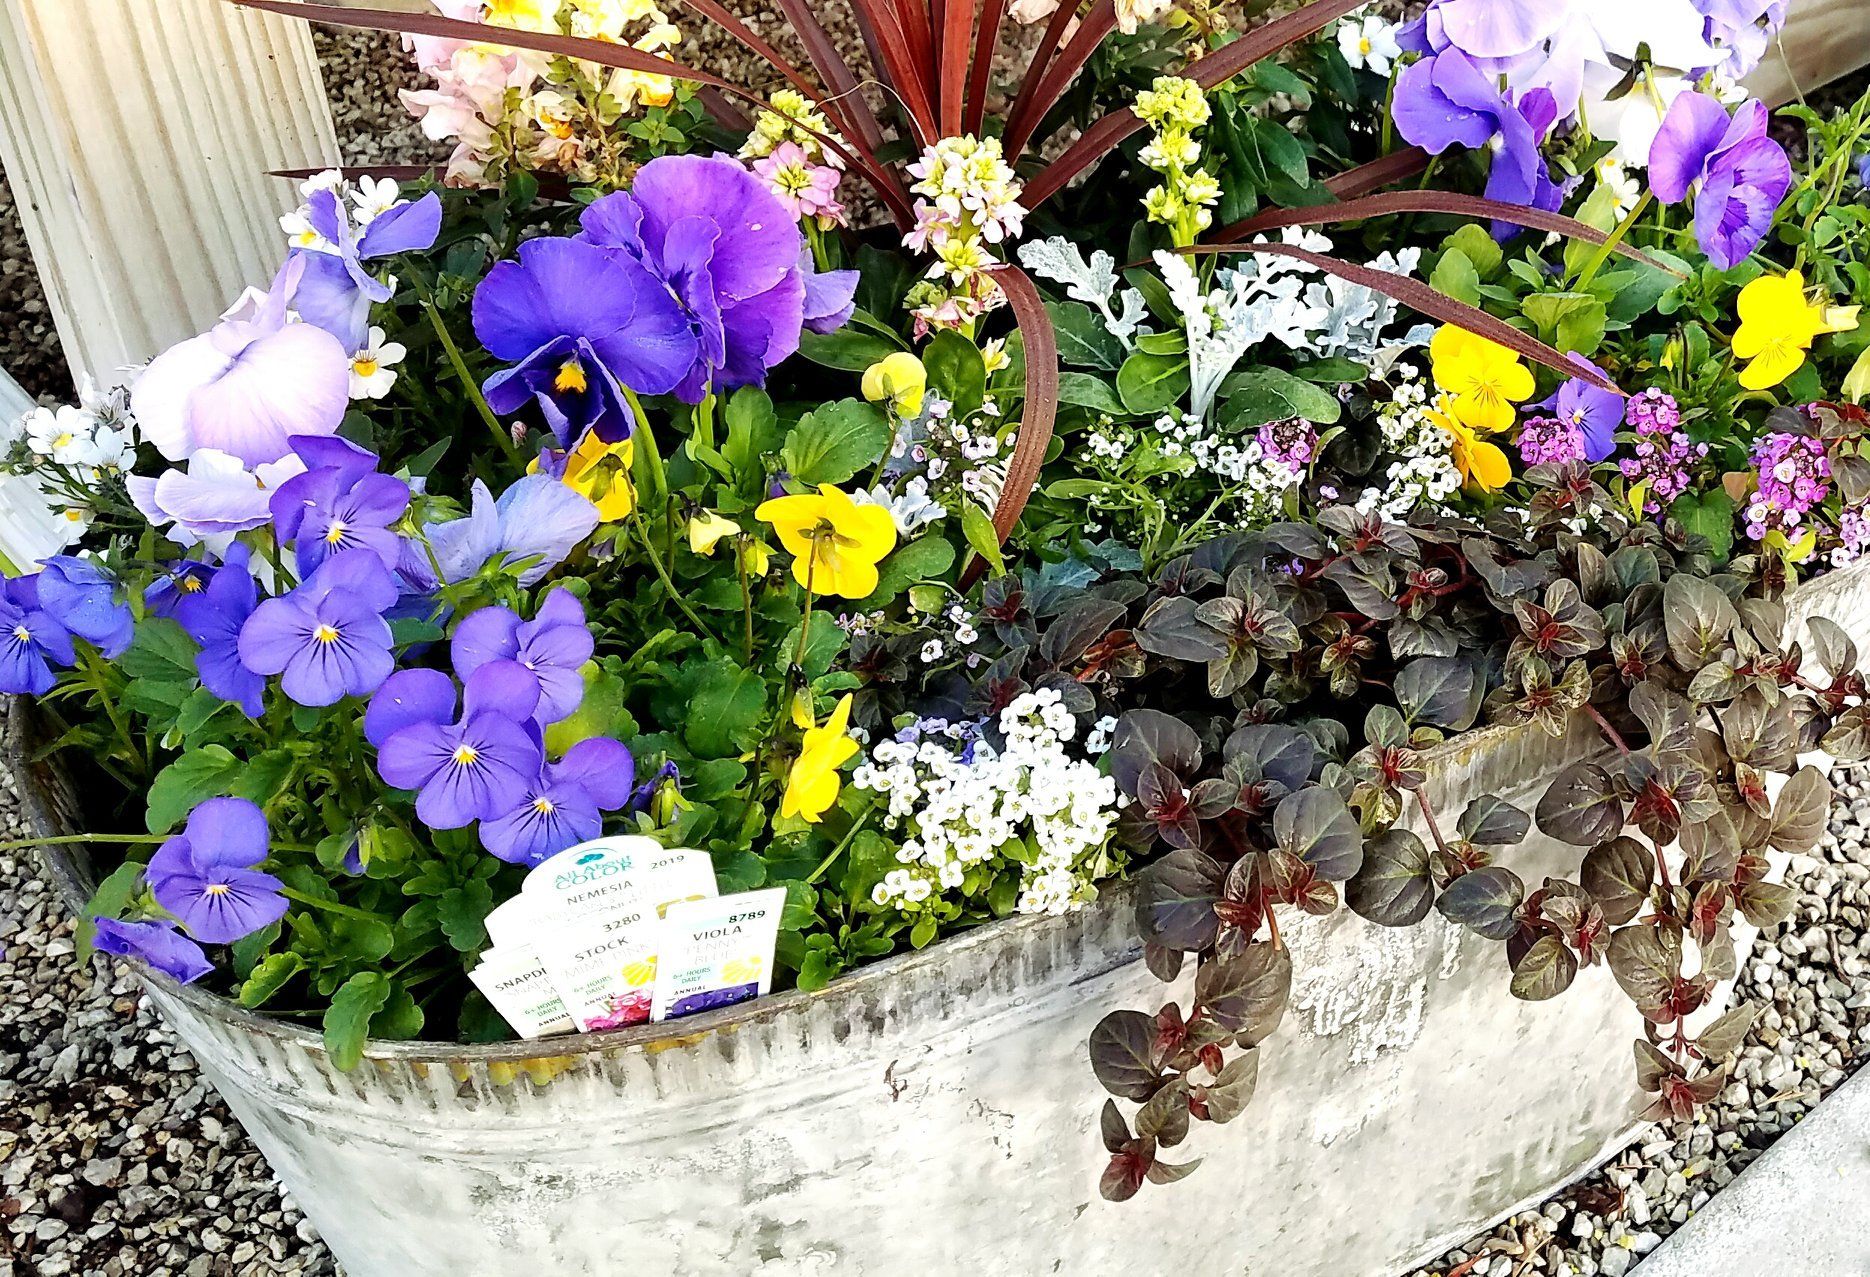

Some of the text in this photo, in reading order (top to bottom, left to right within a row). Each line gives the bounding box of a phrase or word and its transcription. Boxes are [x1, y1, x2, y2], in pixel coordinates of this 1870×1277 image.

[651, 855, 685, 870] 2019
[556, 861, 635, 890] COLOR
[567, 880, 633, 905] NEMESIA
[602, 913, 641, 932] 3280
[728, 910, 766, 924] 8789
[693, 925, 742, 941] VIOLA
[574, 936, 629, 962] STOCK
[686, 966, 711, 977] HOURS
[674, 985, 706, 996] ANNUAL
[538, 1012, 570, 1027] ANNUAL
